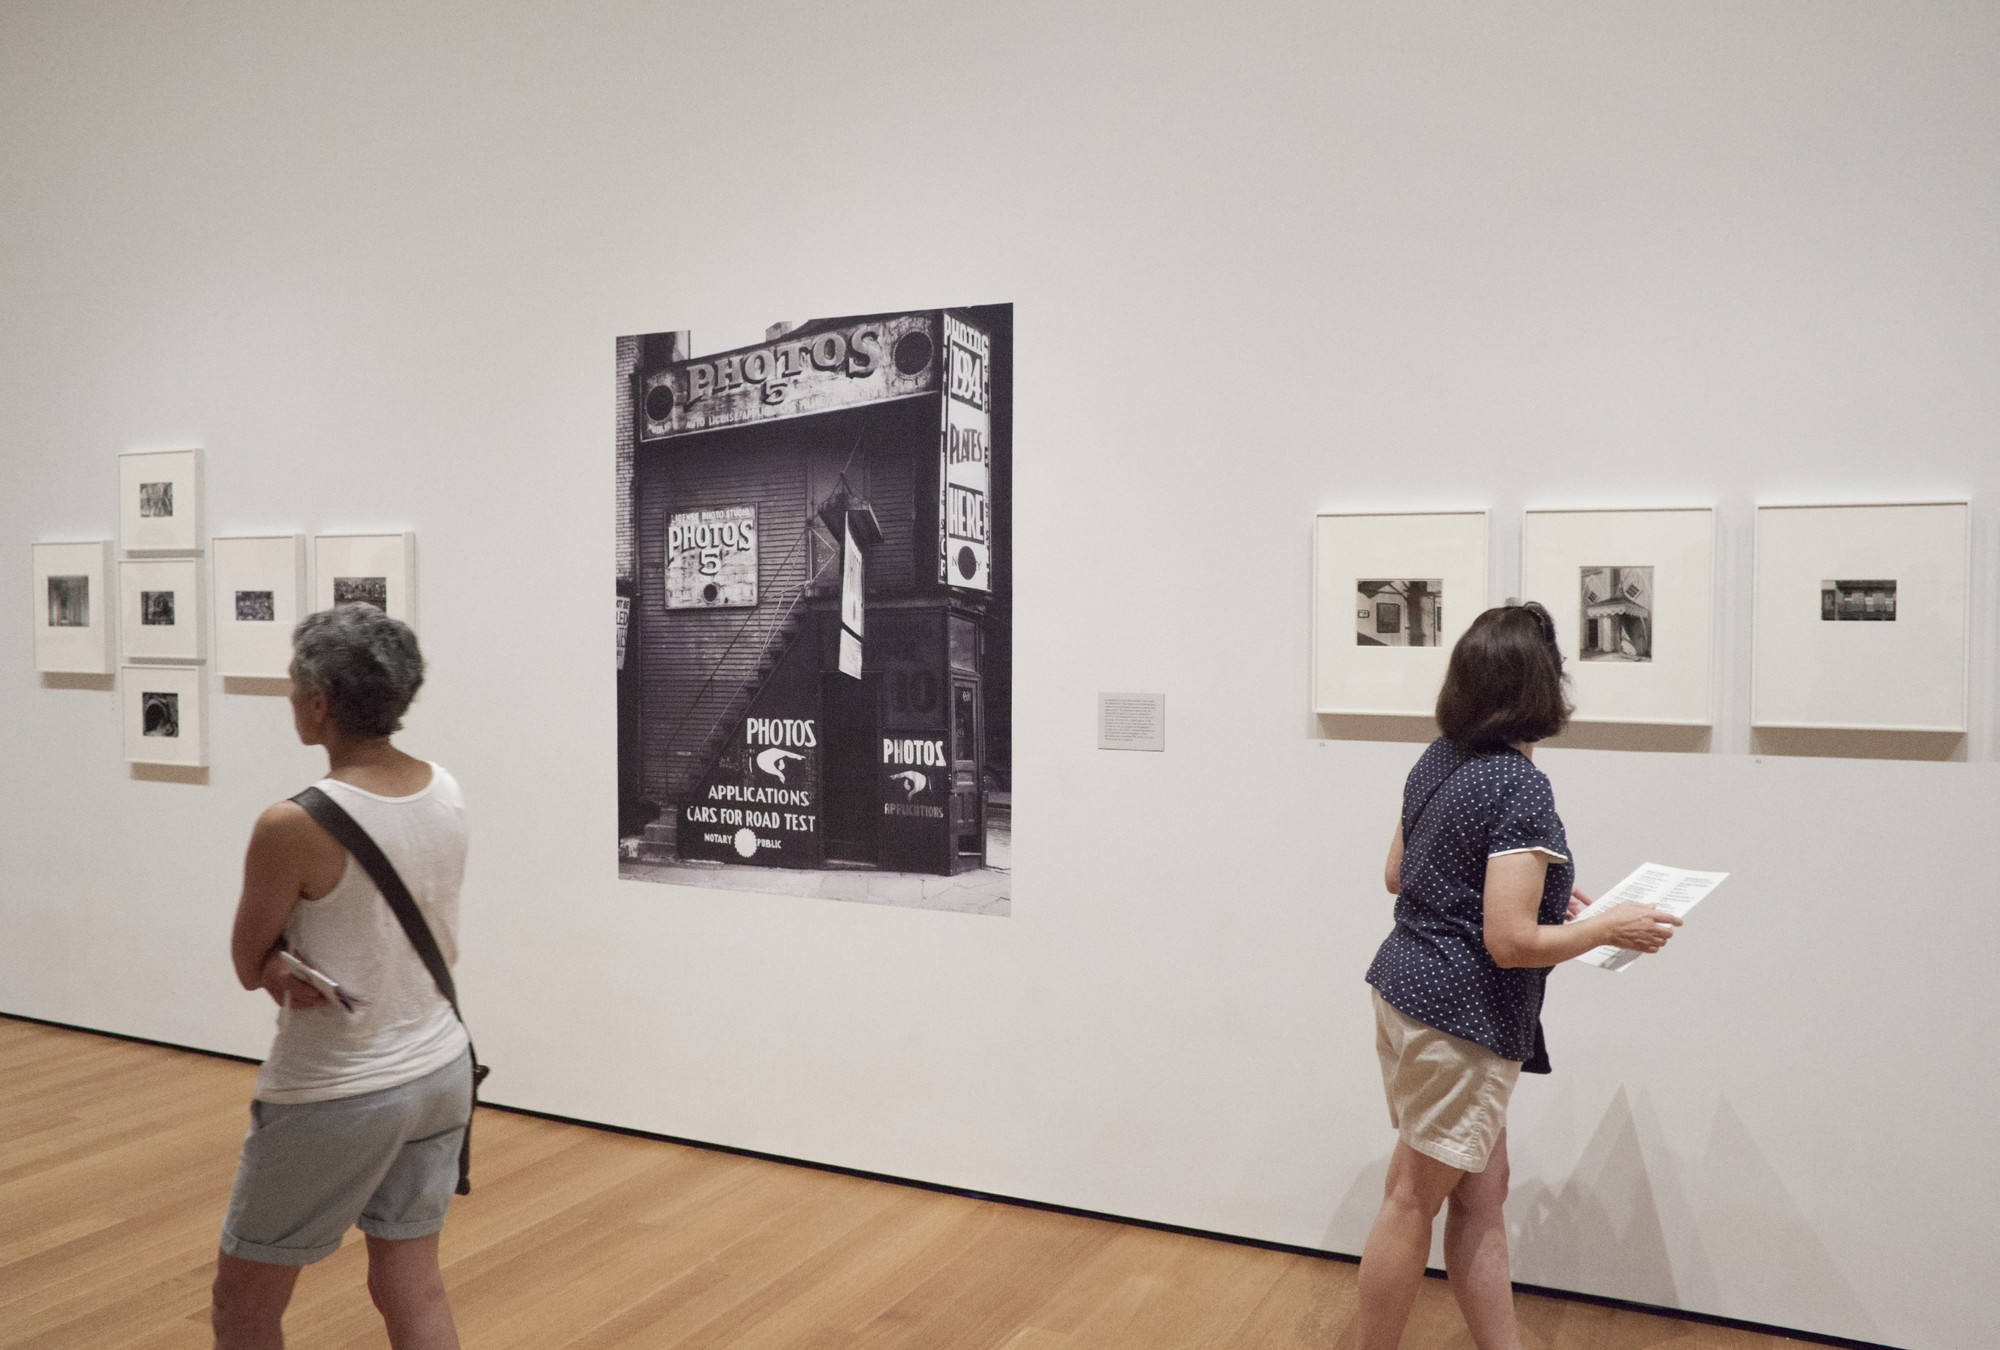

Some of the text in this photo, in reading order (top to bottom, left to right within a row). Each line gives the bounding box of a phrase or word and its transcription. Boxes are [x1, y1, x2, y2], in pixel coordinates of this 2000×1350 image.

[944, 313, 989, 361] PHOTOS
[685, 325, 882, 407] PHOTOS
[952, 345, 982, 405] 1934
[949, 423, 983, 465] PLATES
[949, 487, 984, 540] HERE
[668, 521, 753, 563] PHOTOS
[700, 549, 721, 575] 5
[747, 718, 817, 747] PHOTOS
[883, 739, 946, 766] PHOTOS
[708, 785, 810, 806] APPLICATIONS
[687, 806, 815, 832] CARS FOR ROAD TEST
[704, 833, 781, 848] NOTARY PUBLIC
